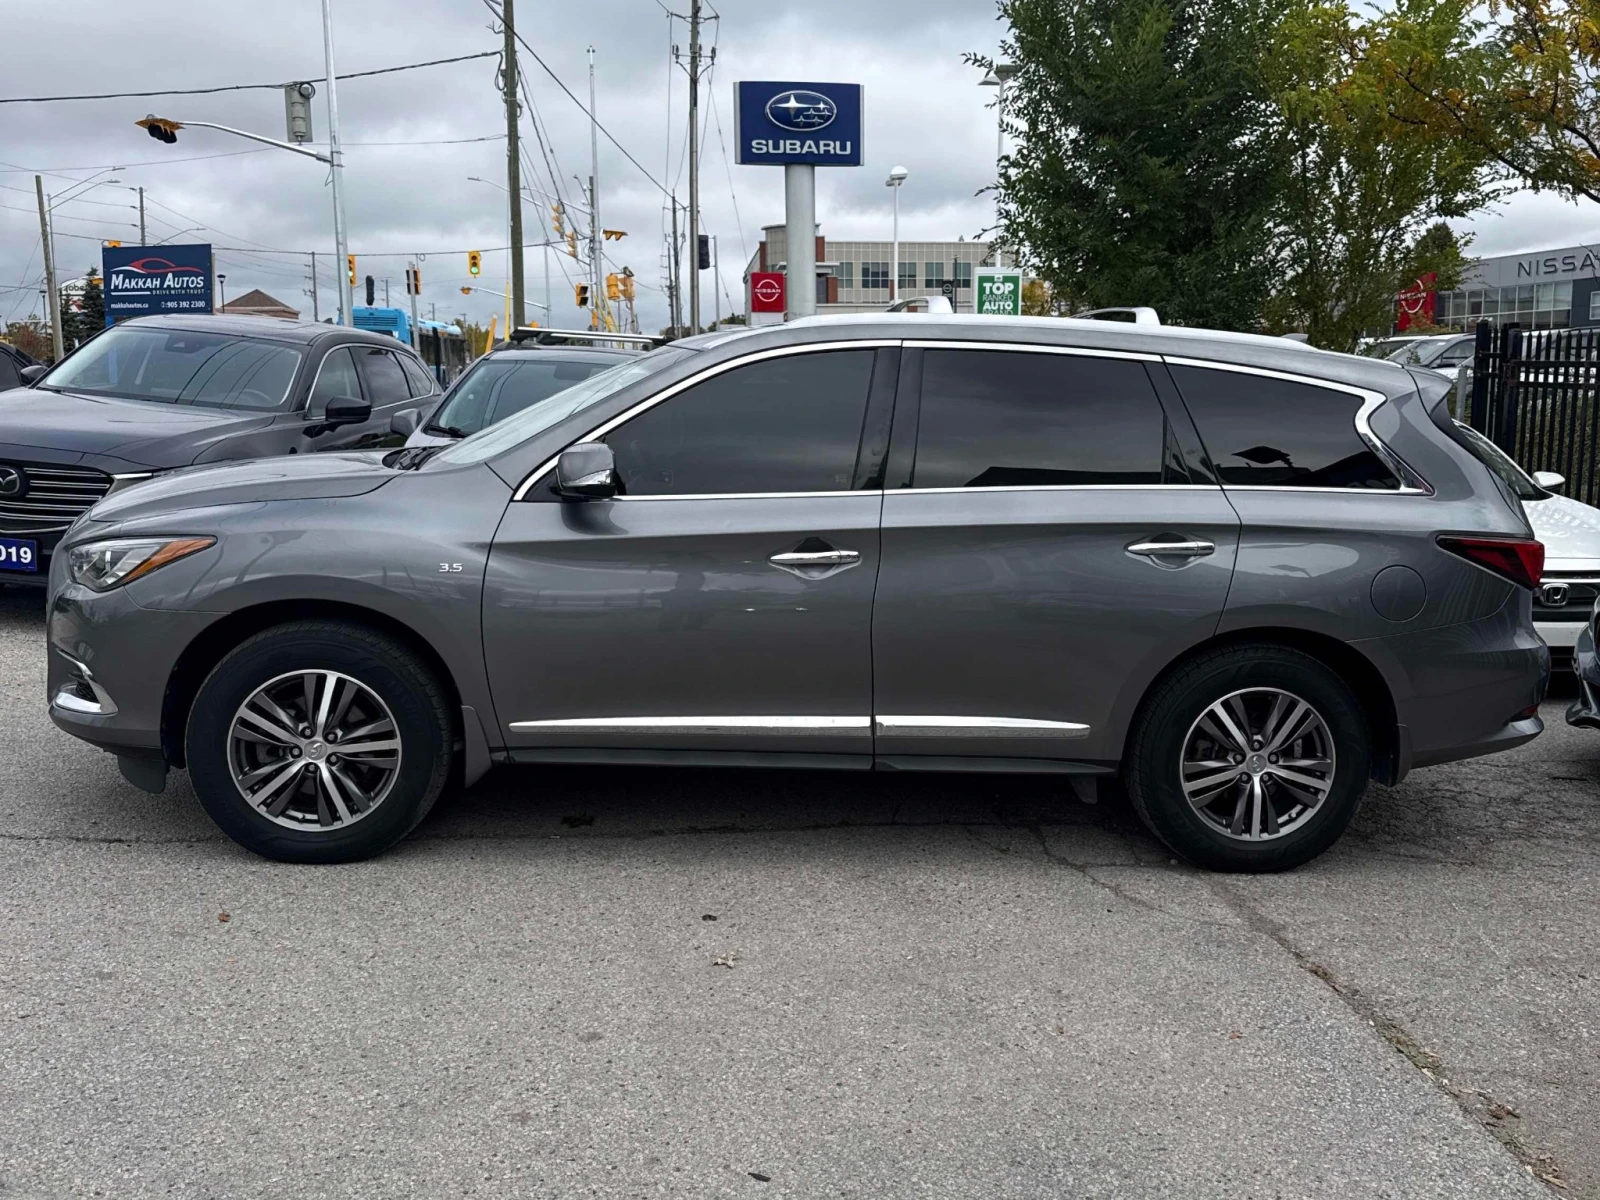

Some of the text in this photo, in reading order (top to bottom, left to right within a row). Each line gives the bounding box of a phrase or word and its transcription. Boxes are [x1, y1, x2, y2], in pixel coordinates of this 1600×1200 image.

[751, 139, 851, 155] SUBARU
[1518, 253, 1597, 278] NISSA
[110, 272, 204, 290] MAKKAH AUTOS
[982, 282, 1014, 295] TOP
[982, 294, 1014, 302] RANKED
[191, 300, 206, 308] 2300
[983, 301, 1014, 310] AUTO
[439, 563, 463, 572] 3.5
